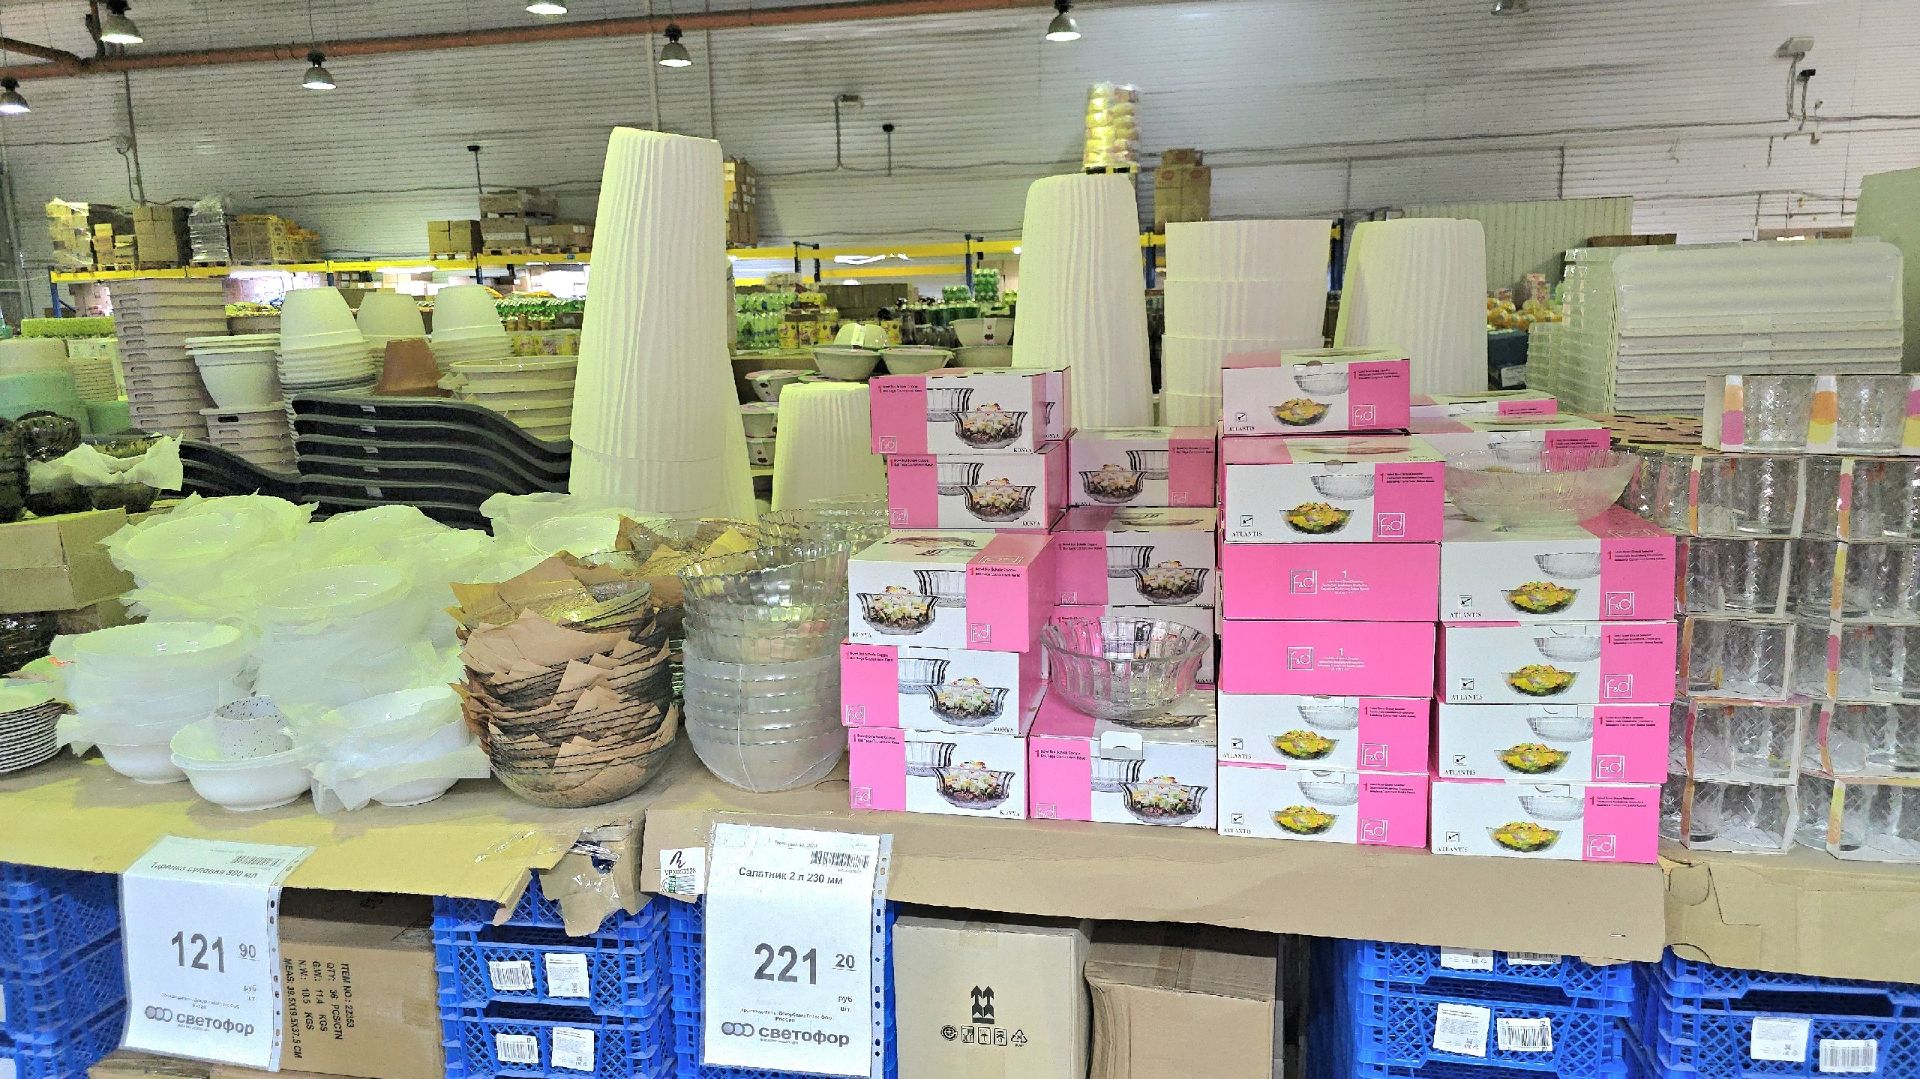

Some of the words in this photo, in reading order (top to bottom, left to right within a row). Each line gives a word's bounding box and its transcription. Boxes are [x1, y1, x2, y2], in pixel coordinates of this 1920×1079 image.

[738, 866, 787, 882] Салатник
[789, 871, 796, 881] 2
[797, 873, 805, 881] л
[807, 873, 825, 883] 230
[827, 877, 843, 885] мм
[171, 931, 225, 973] 121
[239, 943, 256, 958] 90
[312, 960, 322, 982] G.W.:
[326, 962, 336, 982] QTY:
[753, 942, 817, 985] 221
[834, 953, 856, 969] 20
[340, 963, 351, 984] ITEM
[301, 988, 311, 1004] 10.5
[316, 989, 325, 1005] 11.4
[329, 990, 339, 1000] 36
[343, 985, 352, 1003] NO.:
[838, 995, 853, 1004] руб
[282, 958, 295, 984] MEAS:
[293, 1045, 303, 1059] CM
[176, 1012, 255, 1037] светофор
[304, 1012, 314, 1031] KGS
[319, 1014, 327, 1032] KGS
[758, 1026, 850, 1048] светофор
